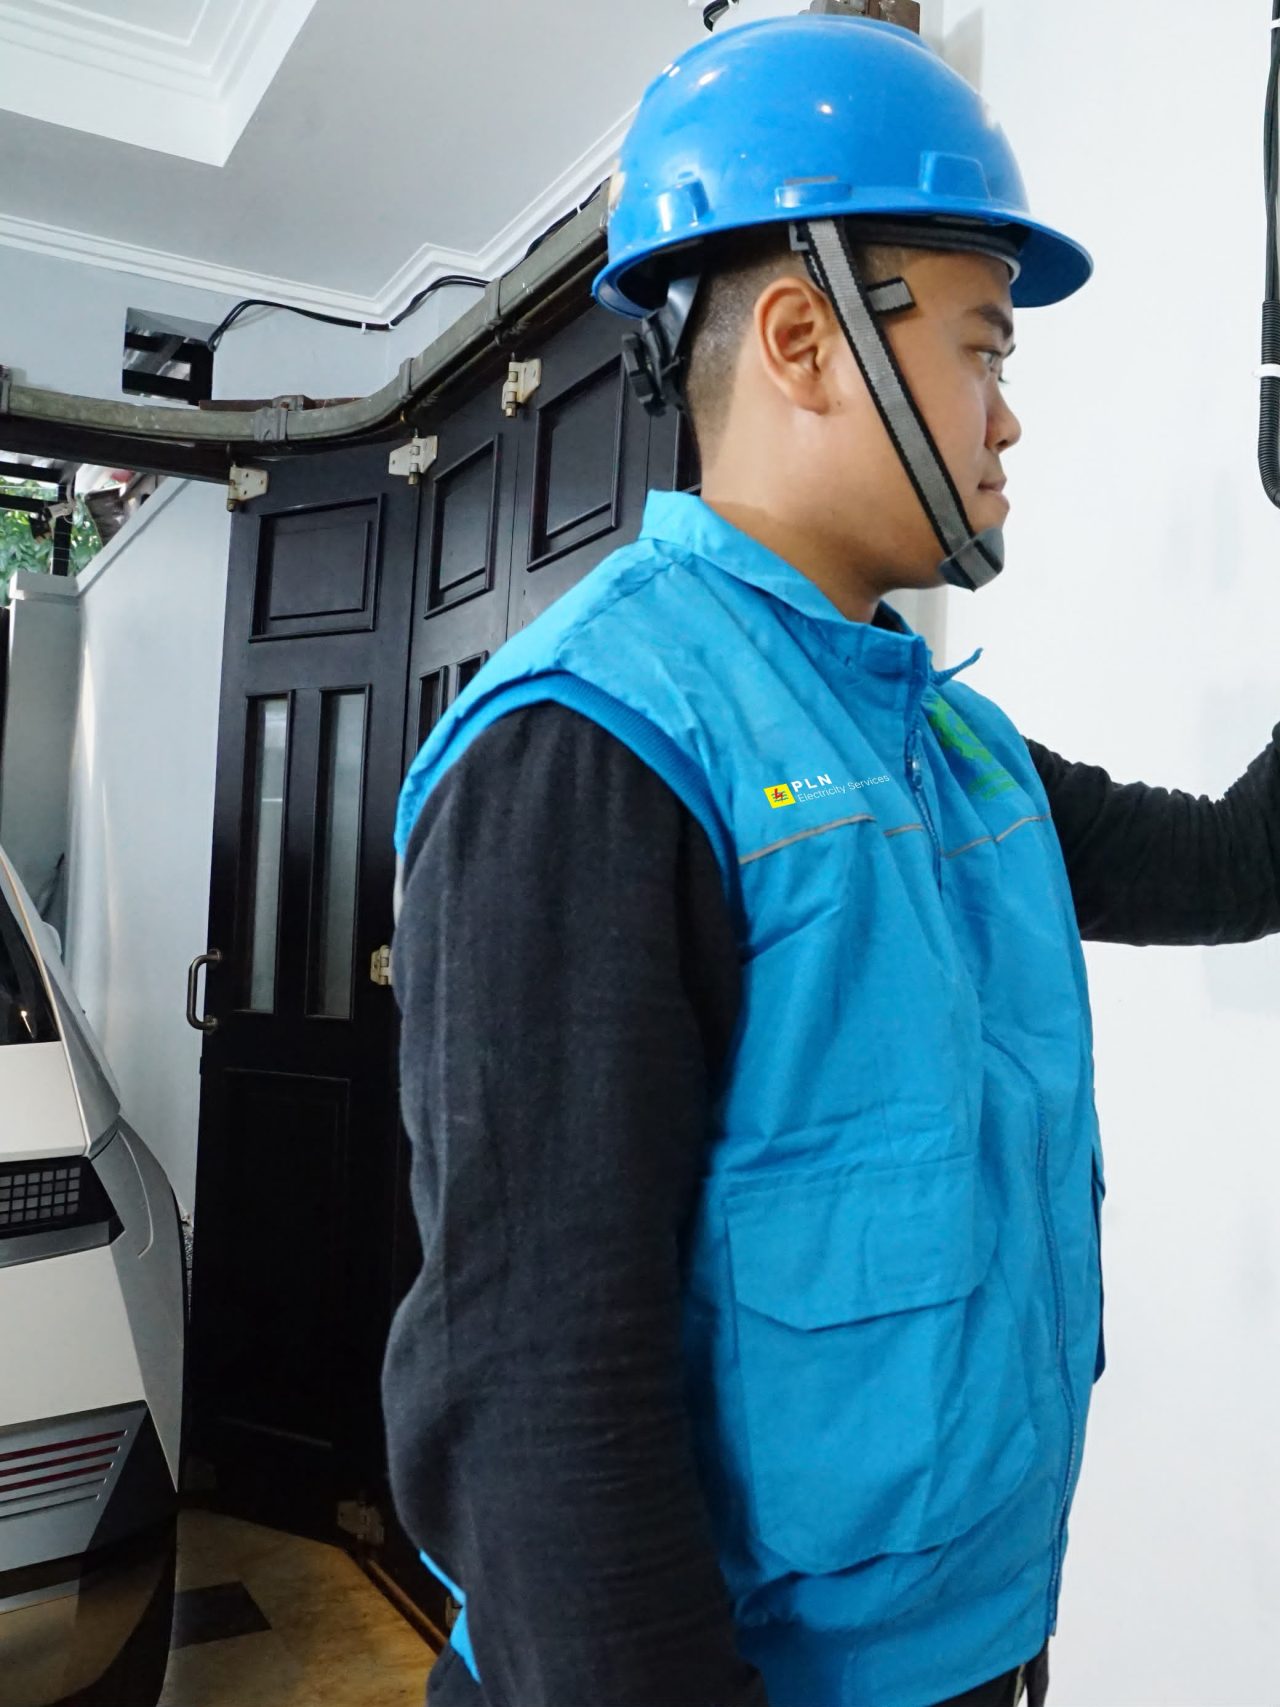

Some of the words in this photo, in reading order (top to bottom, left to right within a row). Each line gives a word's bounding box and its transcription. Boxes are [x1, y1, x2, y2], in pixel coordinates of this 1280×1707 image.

[791, 774, 832, 792] PLN
[797, 785, 846, 802] Electricity
[847, 775, 890, 790] Services
